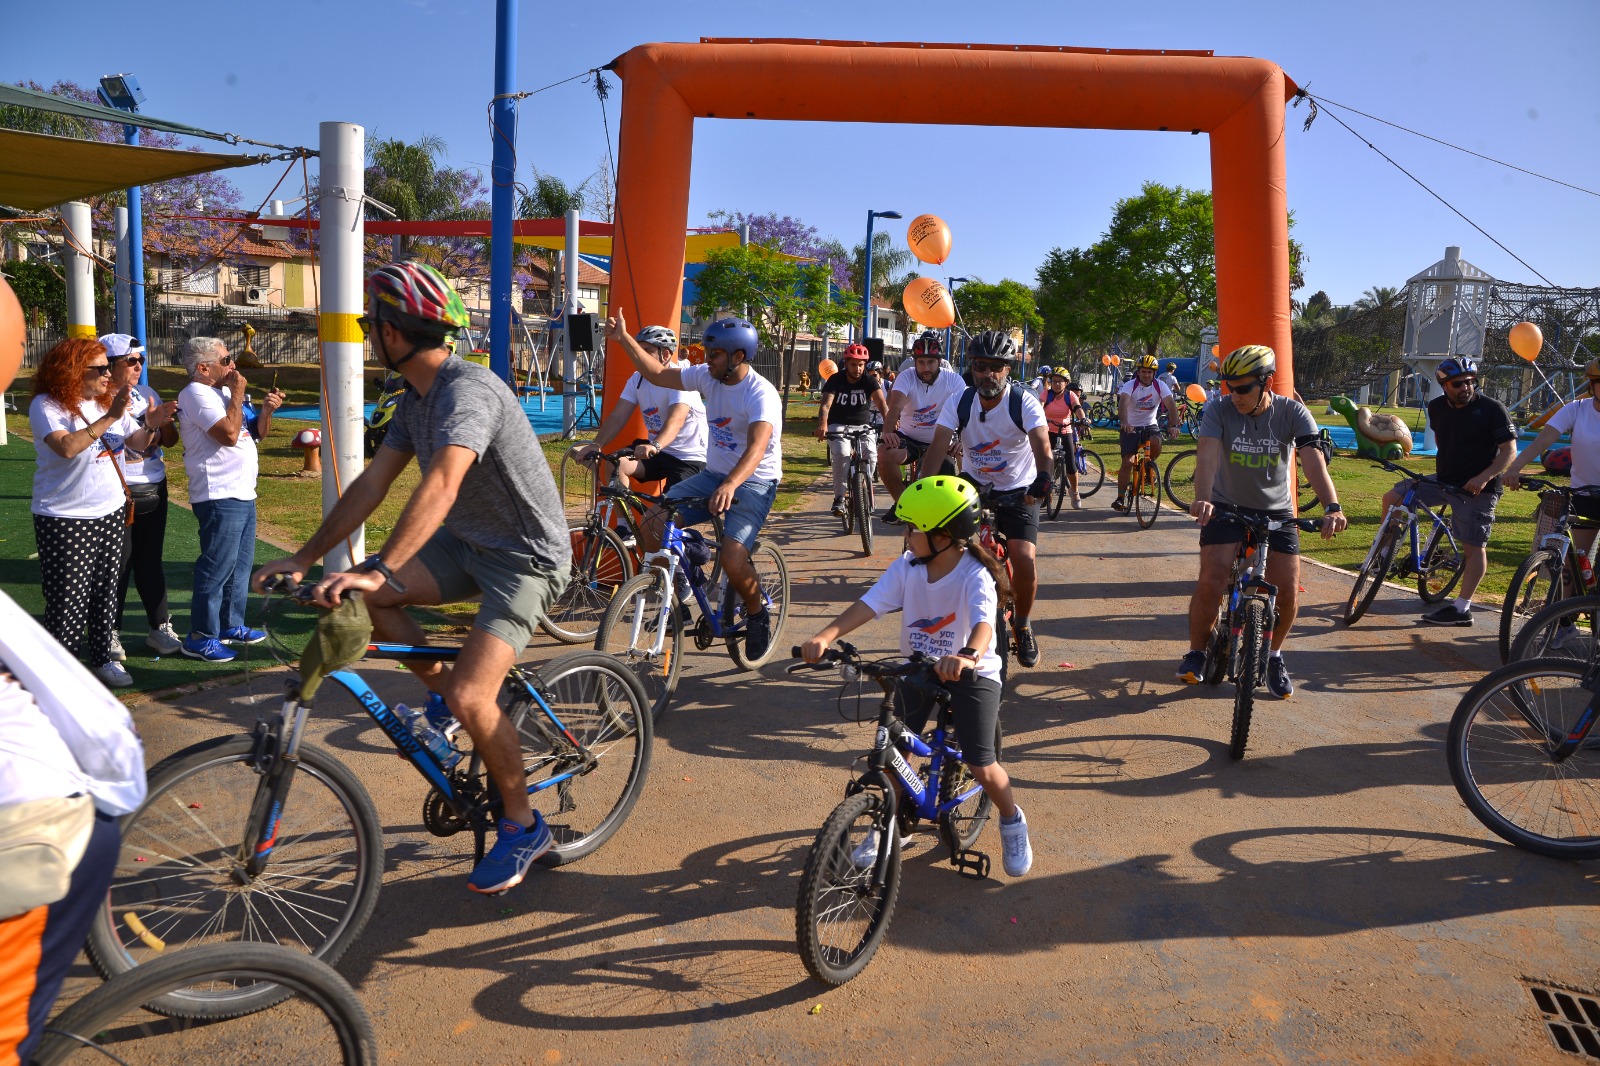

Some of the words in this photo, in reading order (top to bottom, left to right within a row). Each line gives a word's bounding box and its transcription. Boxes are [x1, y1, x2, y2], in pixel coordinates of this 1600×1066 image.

[836, 393, 866, 405] ICON
[1233, 437, 1253, 445] ALL
[1231, 444, 1263, 453] NEED
[1230, 452, 1281, 468] RUN
[358, 690, 421, 754] RAINBOW
